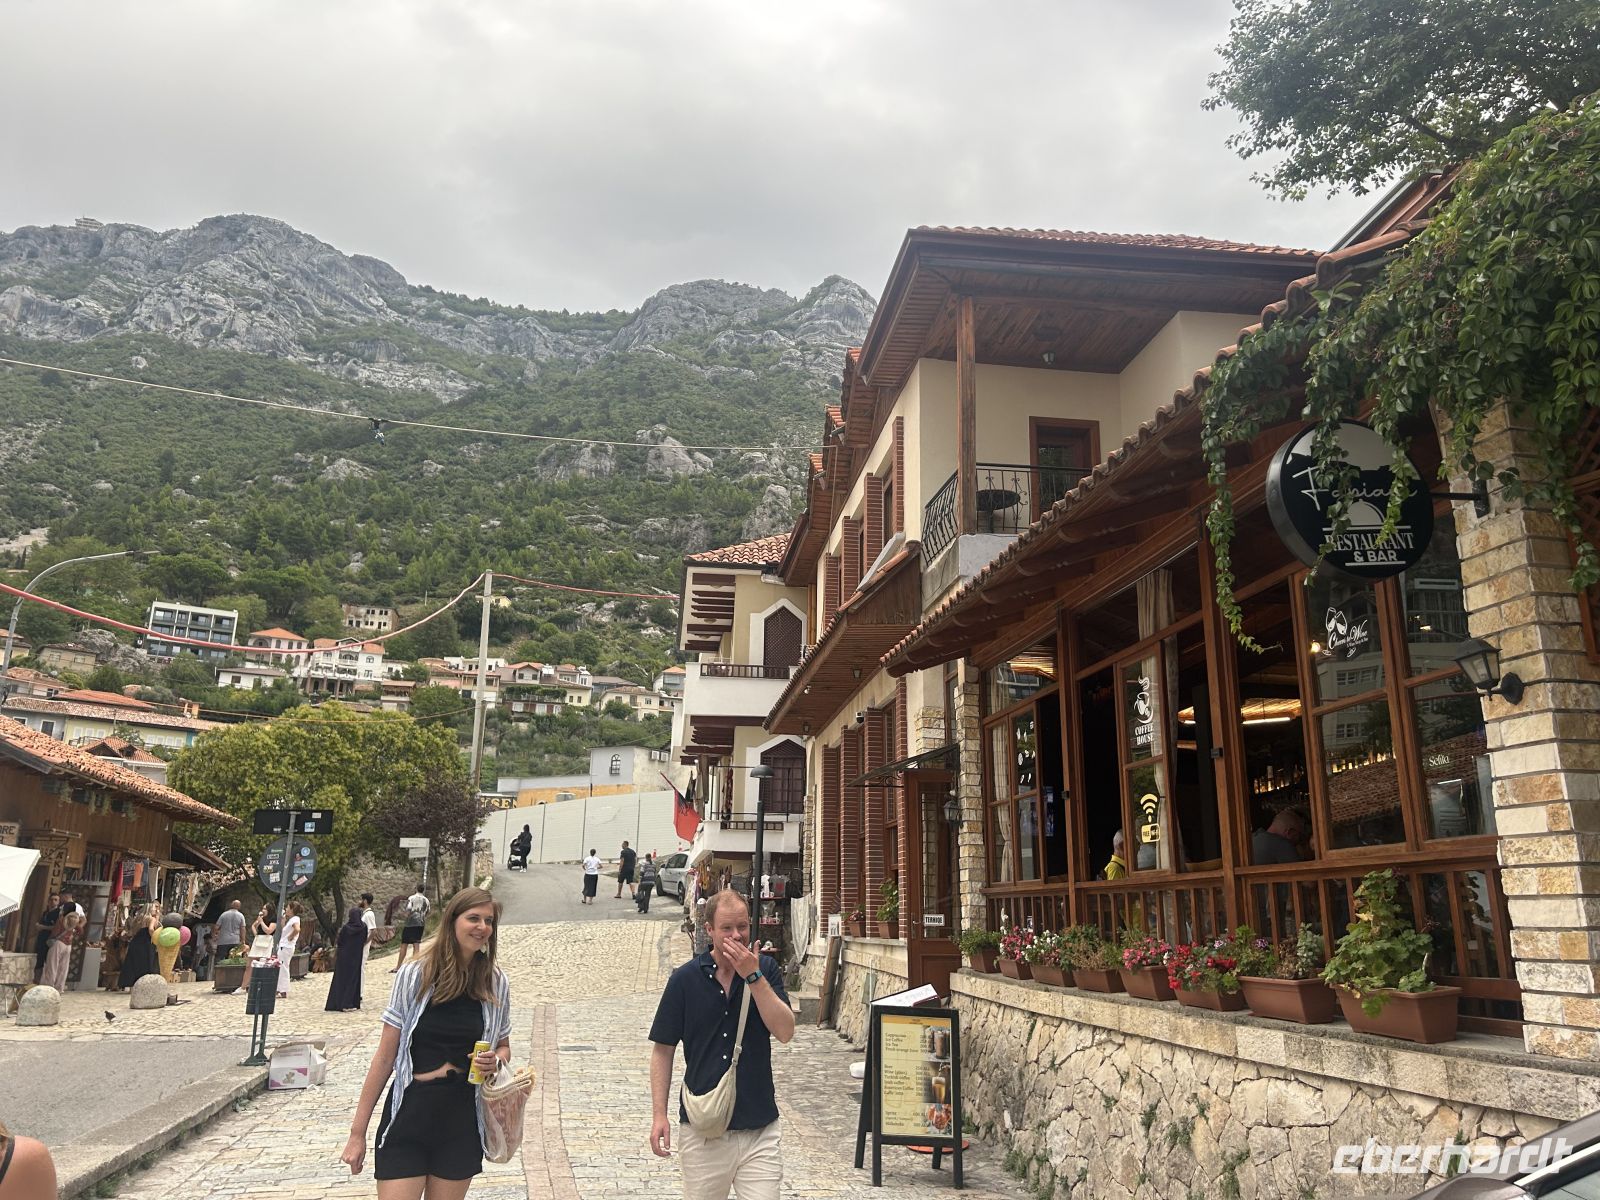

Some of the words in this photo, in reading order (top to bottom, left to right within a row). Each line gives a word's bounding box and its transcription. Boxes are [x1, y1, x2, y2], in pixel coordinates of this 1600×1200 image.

[1354, 551, 1364, 563] &
[1367, 550, 1398, 563] BAR
[1135, 724, 1154, 736] COFFEE
[1136, 732, 1154, 746] HOUSE
